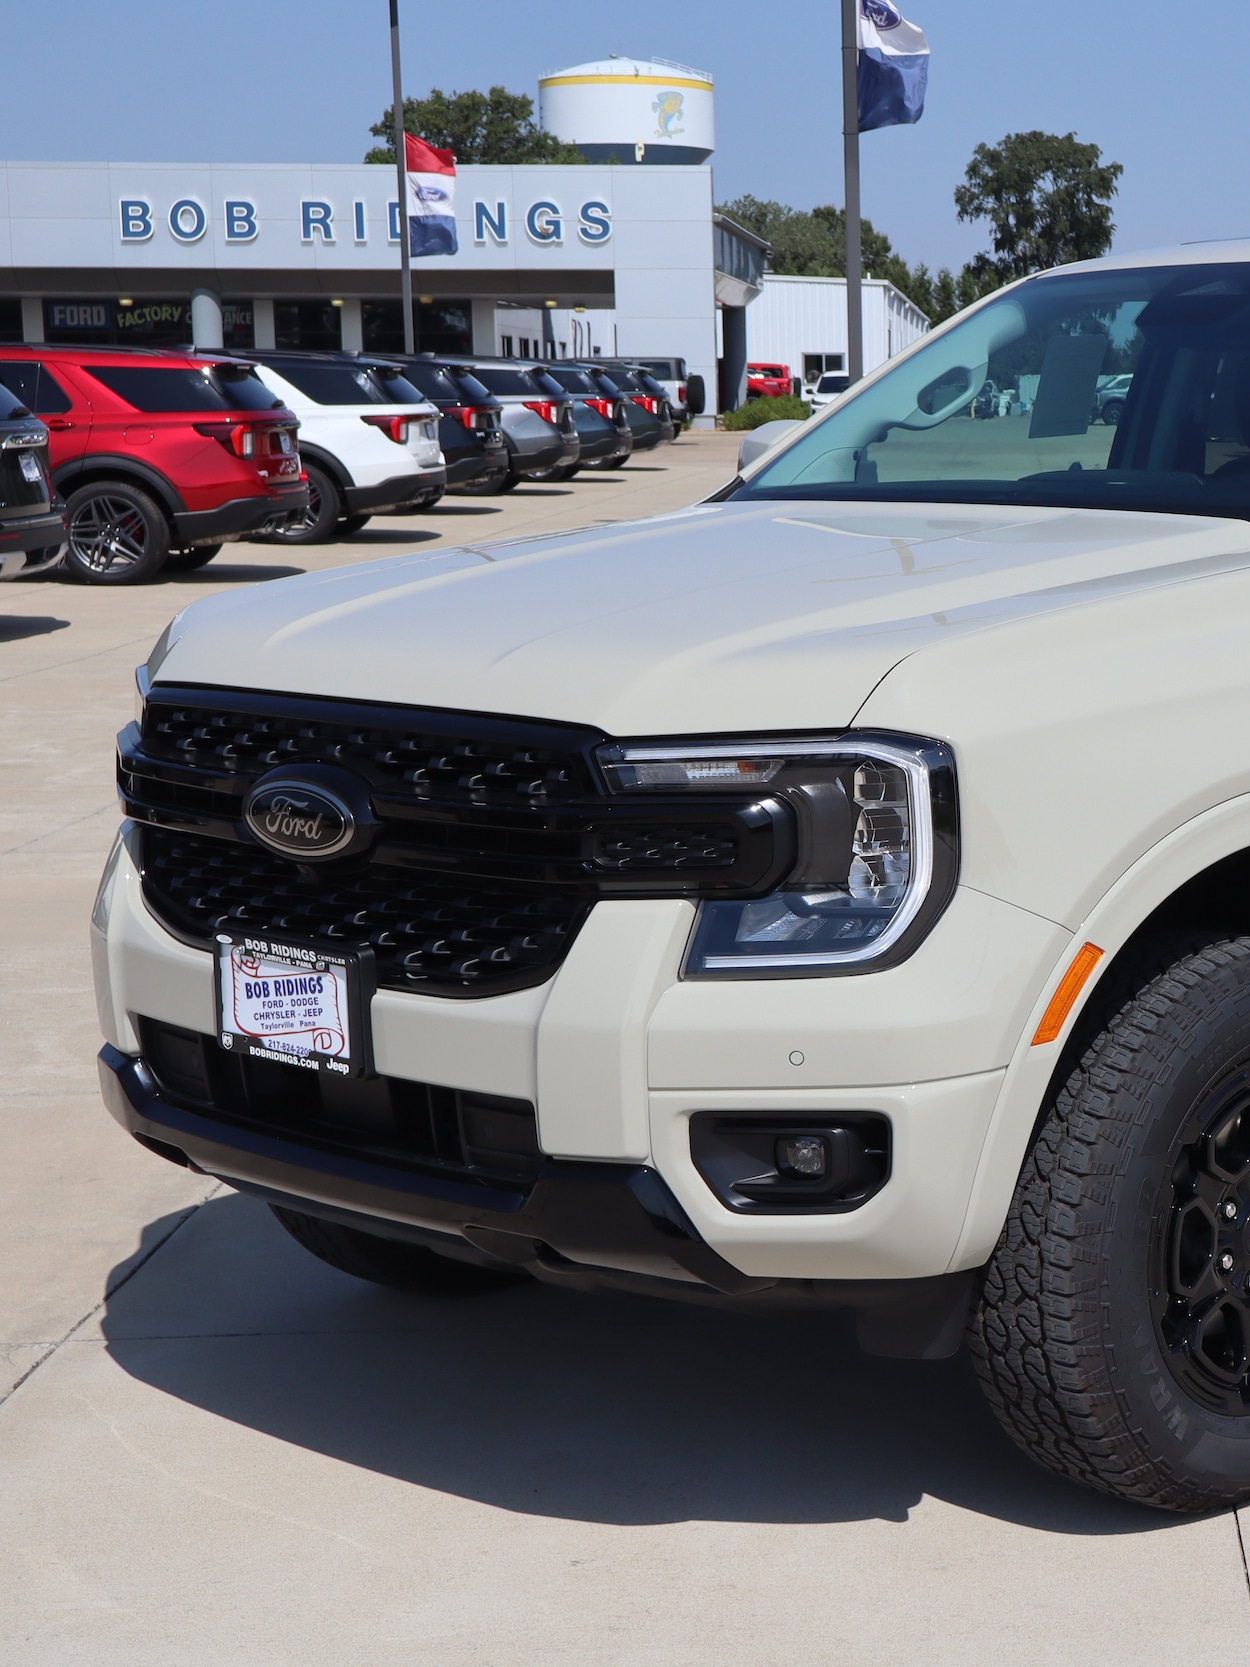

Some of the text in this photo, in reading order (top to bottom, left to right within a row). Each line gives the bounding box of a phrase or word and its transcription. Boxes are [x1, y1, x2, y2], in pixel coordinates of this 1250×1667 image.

[119, 197, 613, 243] BOB RINGS
[53, 304, 106, 326] FORD
[116, 306, 182, 328] FACTORY
[185, 311, 252, 325] CANCE
[265, 795, 323, 840] Ford
[244, 938, 269, 953] BOB
[270, 943, 317, 962] RIDINGS
[251, 951, 291, 965] TAYLORVILLE
[295, 960, 313, 969] PANA
[245, 976, 324, 999] BOB RIDINGS
[262, 999, 284, 1009] FORD
[290, 997, 319, 1007] DODGE
[253, 1010, 296, 1021] CHRYSLER
[303, 1008, 323, 1018] JEEP
[260, 1019, 316, 1031] Taylorville Pana
[249, 1045, 320, 1071] BOBRIDINGS.COM
[268, 1039, 312, 1057] 217-824-220
[326, 1058, 350, 1075] Jeep
